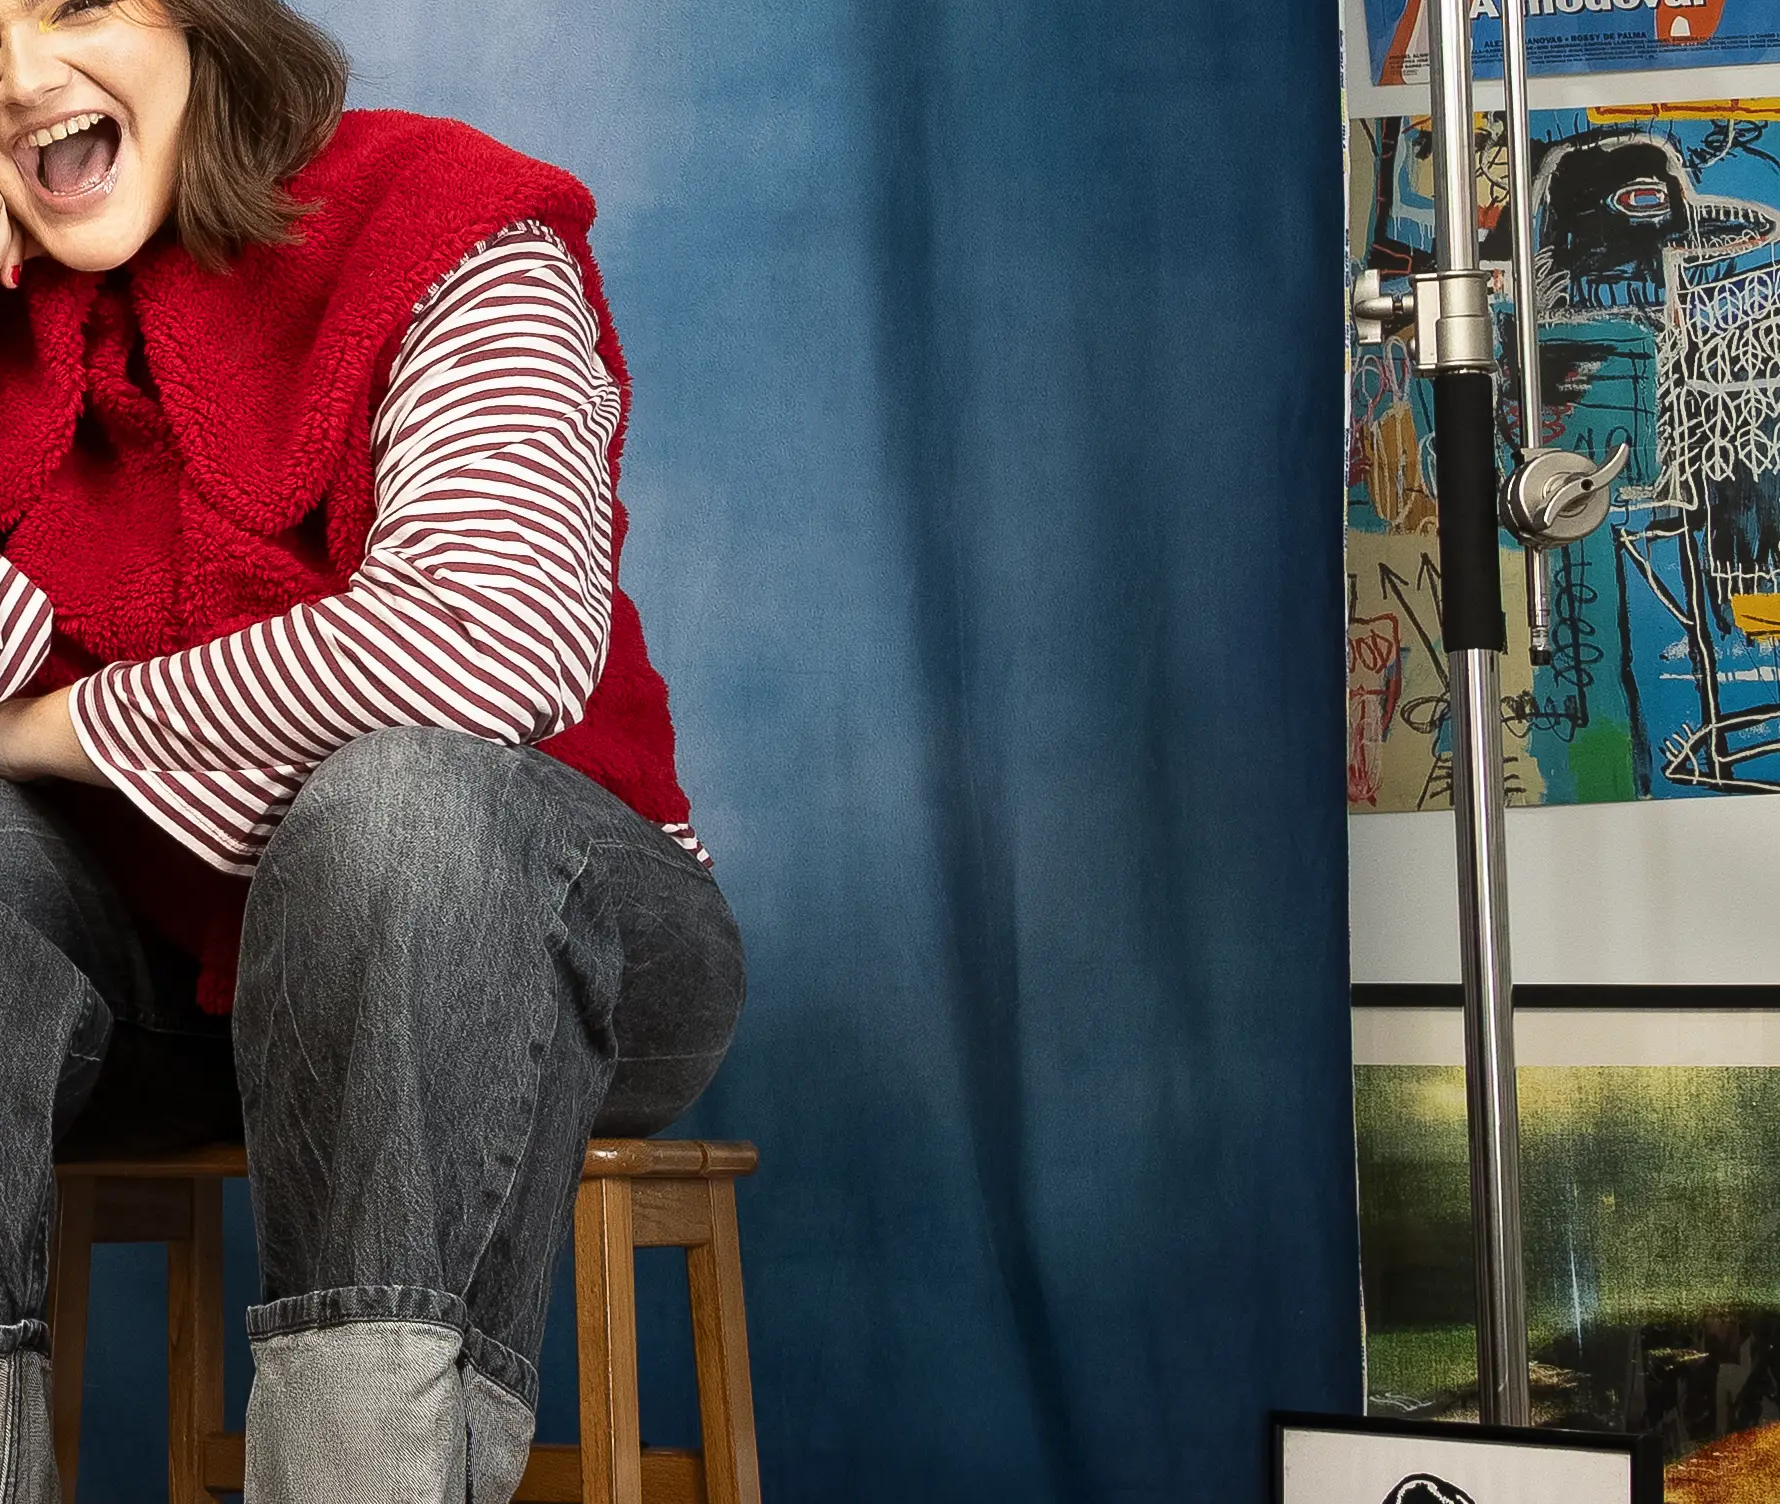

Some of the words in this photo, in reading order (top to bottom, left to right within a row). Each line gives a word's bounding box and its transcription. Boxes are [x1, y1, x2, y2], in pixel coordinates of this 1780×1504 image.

[1570, 32, 1602, 43] ROSSY
[1604, 32, 1615, 41] DE
[1616, 30, 1648, 41] PALMA
